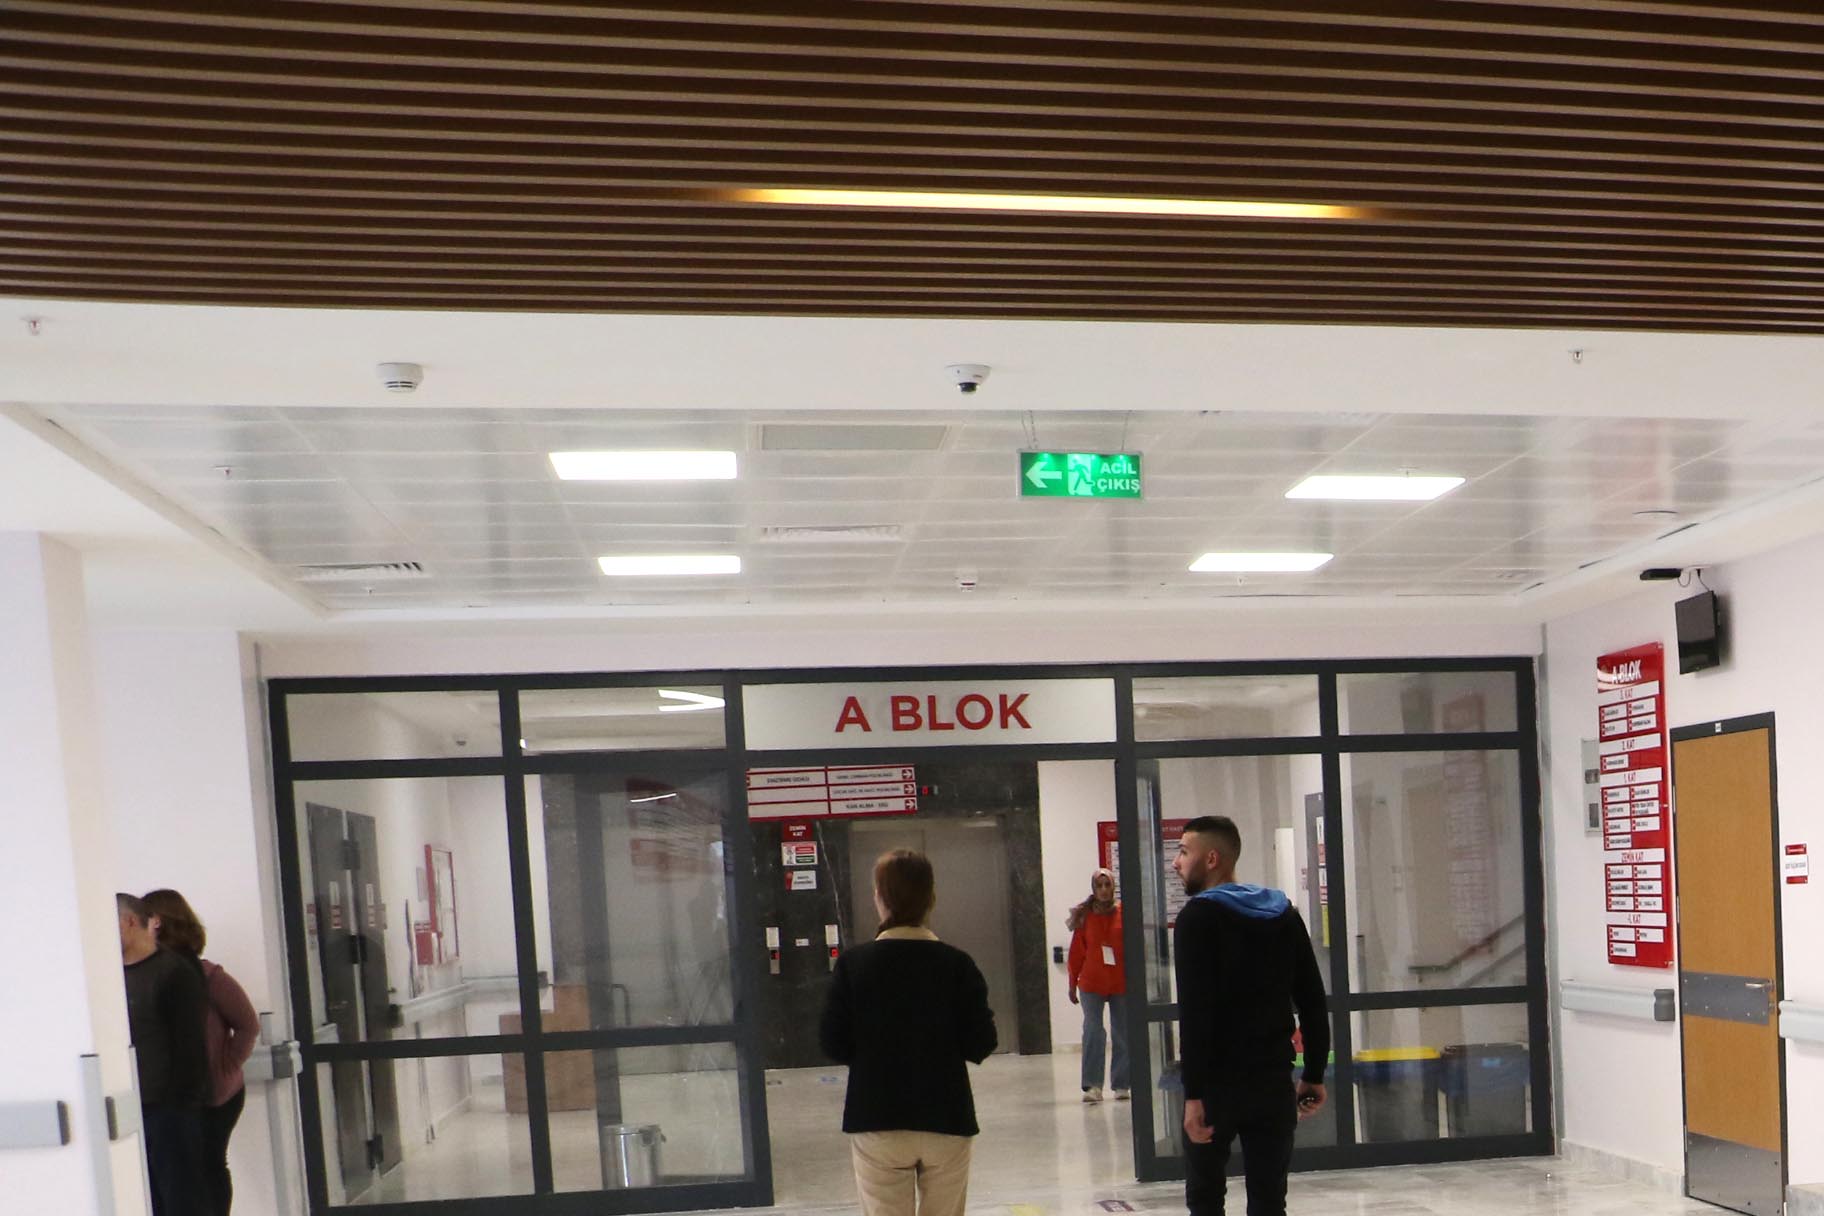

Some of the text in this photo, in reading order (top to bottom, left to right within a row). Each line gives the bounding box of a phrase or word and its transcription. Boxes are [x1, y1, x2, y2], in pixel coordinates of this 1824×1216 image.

[1100, 461, 1137, 475] ACİL
[1097, 478, 1140, 493] ÇIKIŞ
[835, 694, 1032, 732] A BLOK
